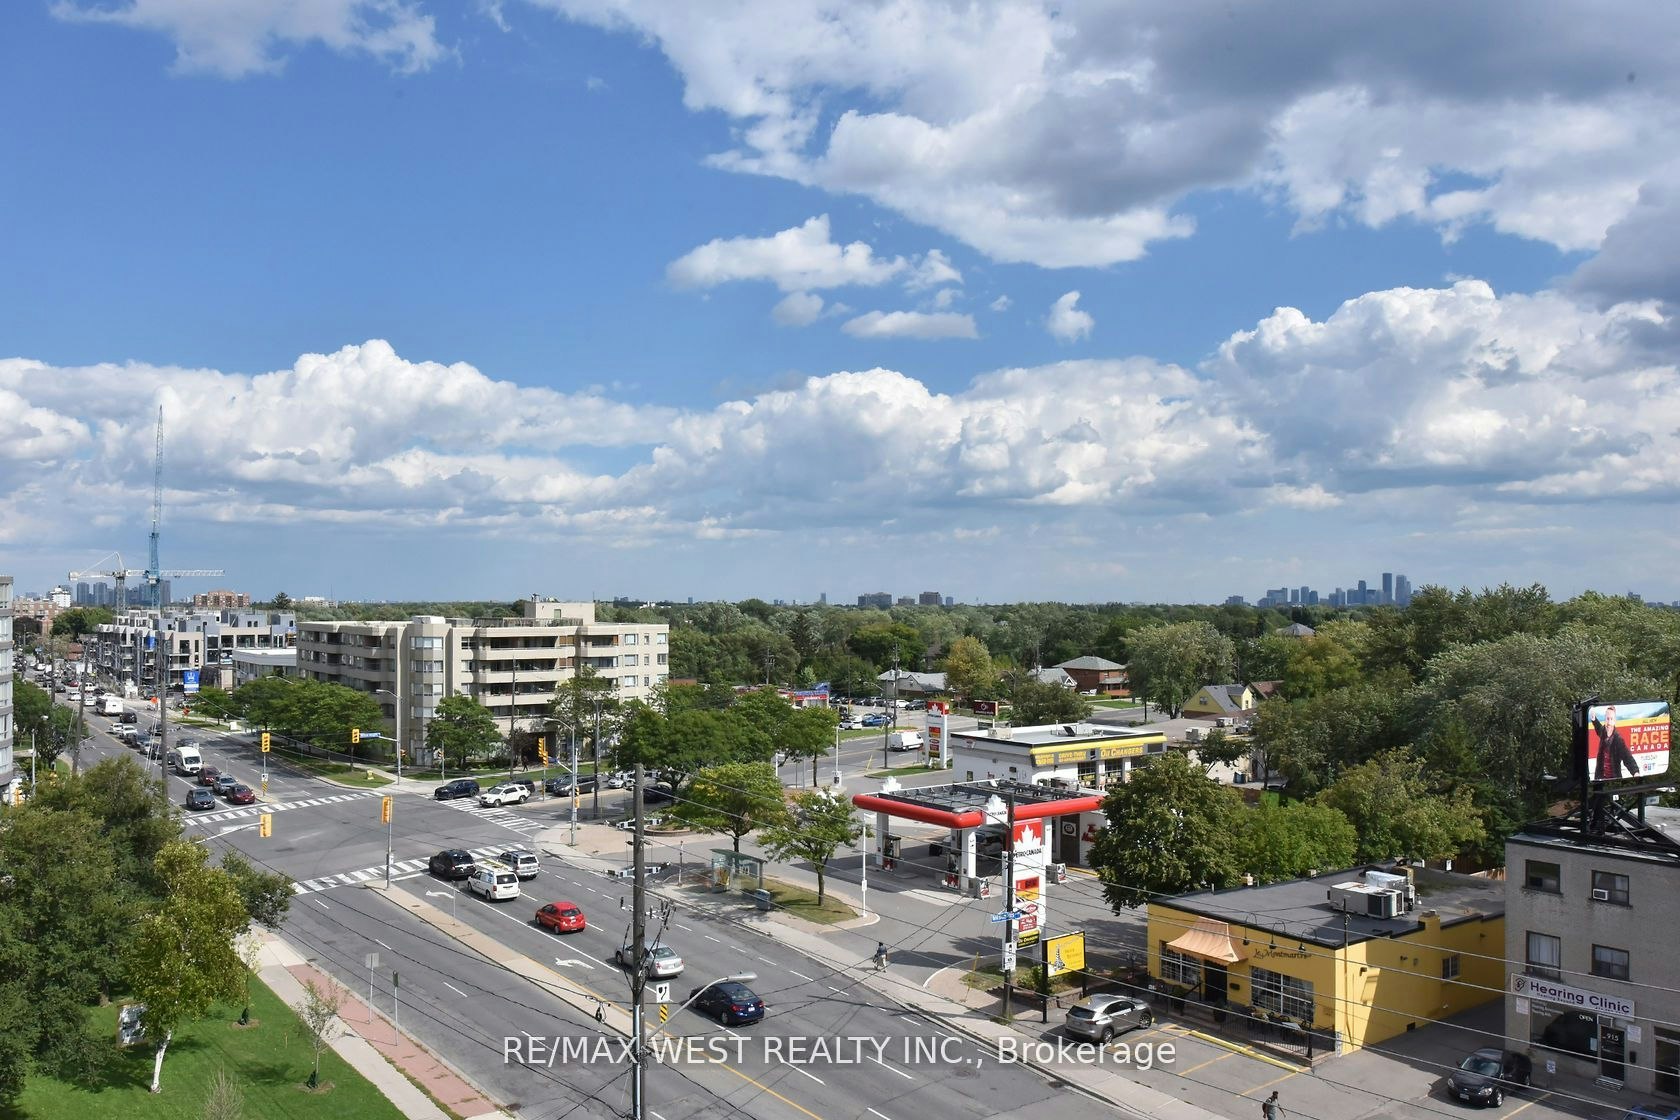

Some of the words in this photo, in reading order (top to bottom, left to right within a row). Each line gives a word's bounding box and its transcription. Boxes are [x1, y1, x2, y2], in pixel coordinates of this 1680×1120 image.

[1630, 731, 1669, 746] RACE
[1630, 743, 1669, 752] CANADA
[1530, 981, 1585, 1005] Hearing
[1589, 995, 1630, 1013] Clinic
[1579, 1014, 1594, 1022] OPEN
[1606, 1032, 1619, 1042] 915
